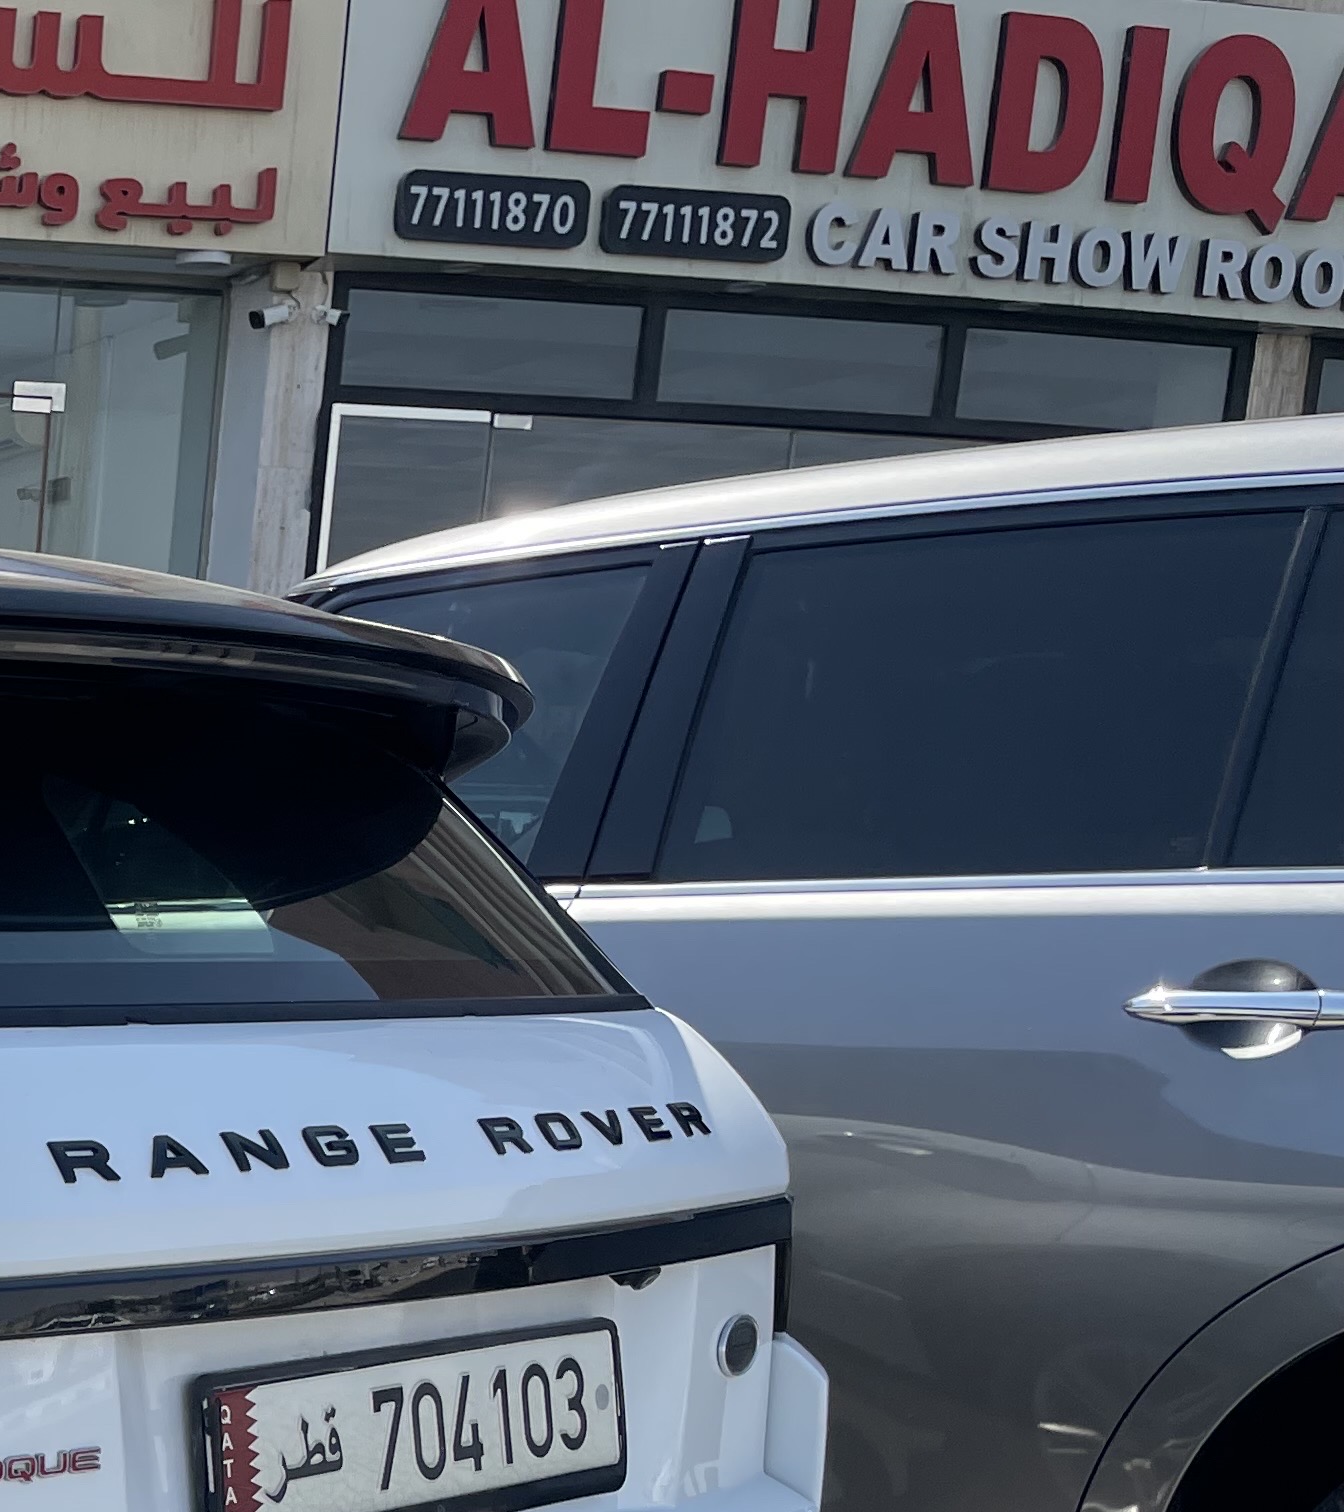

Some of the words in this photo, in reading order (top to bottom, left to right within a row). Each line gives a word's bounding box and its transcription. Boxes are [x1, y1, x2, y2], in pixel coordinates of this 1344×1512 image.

[94, 168, 278, 232] لبيع
[408, 184, 576, 236] 77111870
[618, 200, 780, 251] 77111872
[807, 203, 958, 276] CAR
[970, 217, 1192, 293] SHOW
[1195, 237, 1344, 309] ROO
[47, 1123, 426, 1184] RANGE
[477, 1101, 712, 1155] ROVER
[266, 1404, 343, 1503] قطر
[373, 1356, 587, 1491] 704103
